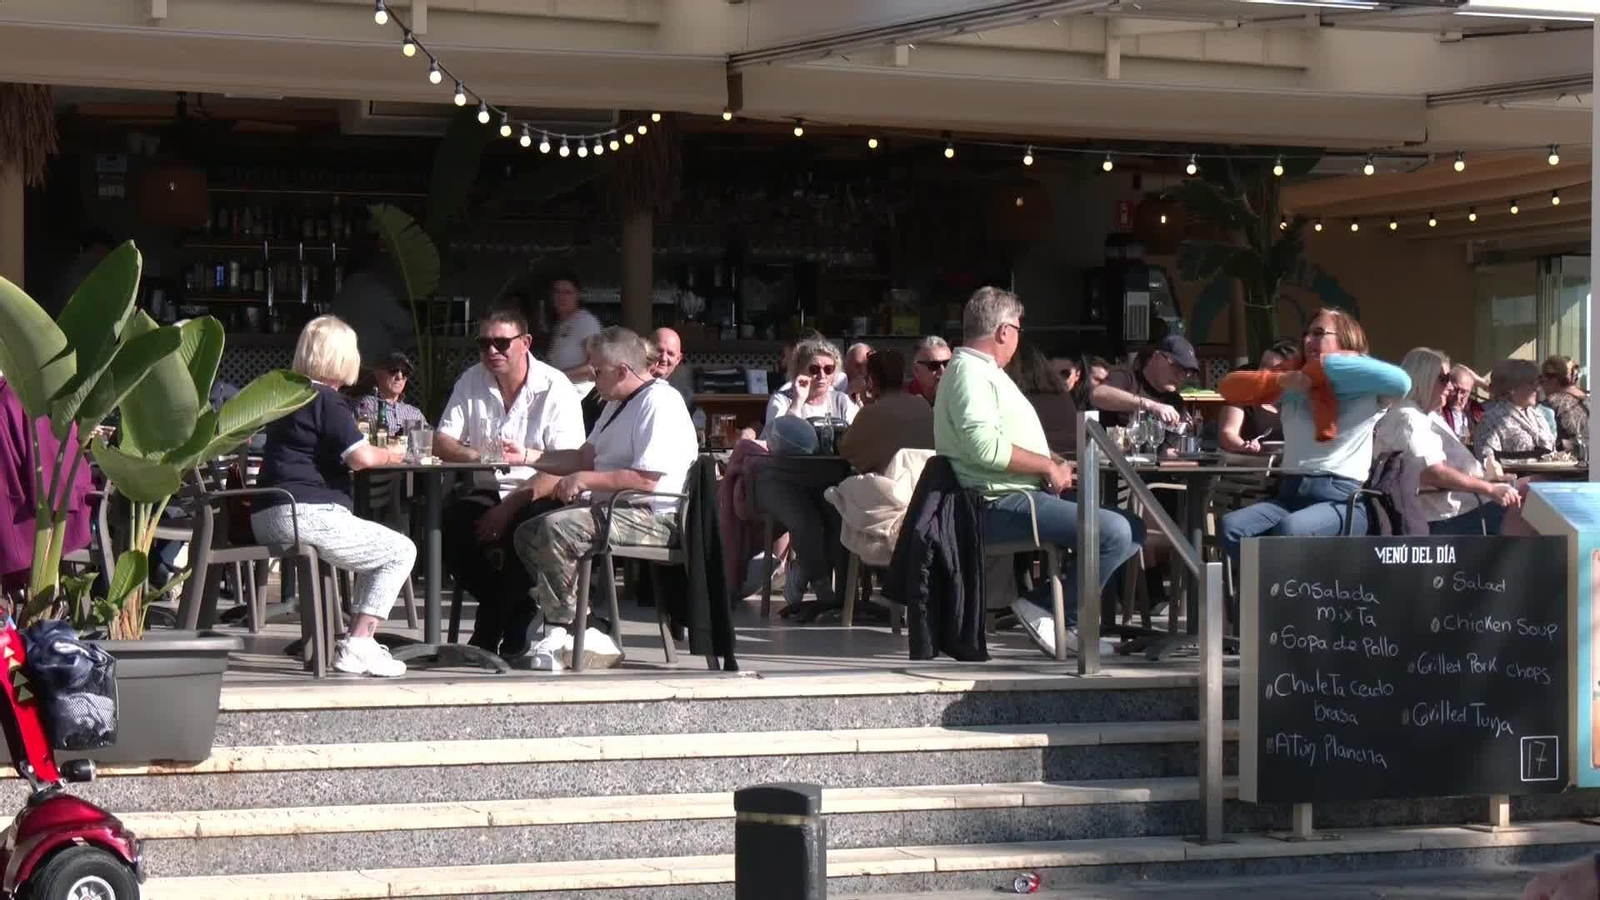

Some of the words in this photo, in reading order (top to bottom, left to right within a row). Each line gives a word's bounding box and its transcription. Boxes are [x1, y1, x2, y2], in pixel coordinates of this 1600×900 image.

[1375, 544, 1408, 564] MENÚ
[1412, 546, 1433, 564] DEL
[1436, 544, 1456, 564] DÍA
[1453, 571, 1506, 592] Salad
[1516, 618, 1558, 641] Soup
[1281, 625, 1328, 653] Sopa
[1333, 635, 1358, 651] de
[1362, 636, 1399, 658] Pollo
[1417, 652, 1461, 675] Grilled
[1314, 700, 1358, 725] brasa
[1413, 700, 1467, 727] Grilled
[1469, 702, 1514, 738] Tuna
